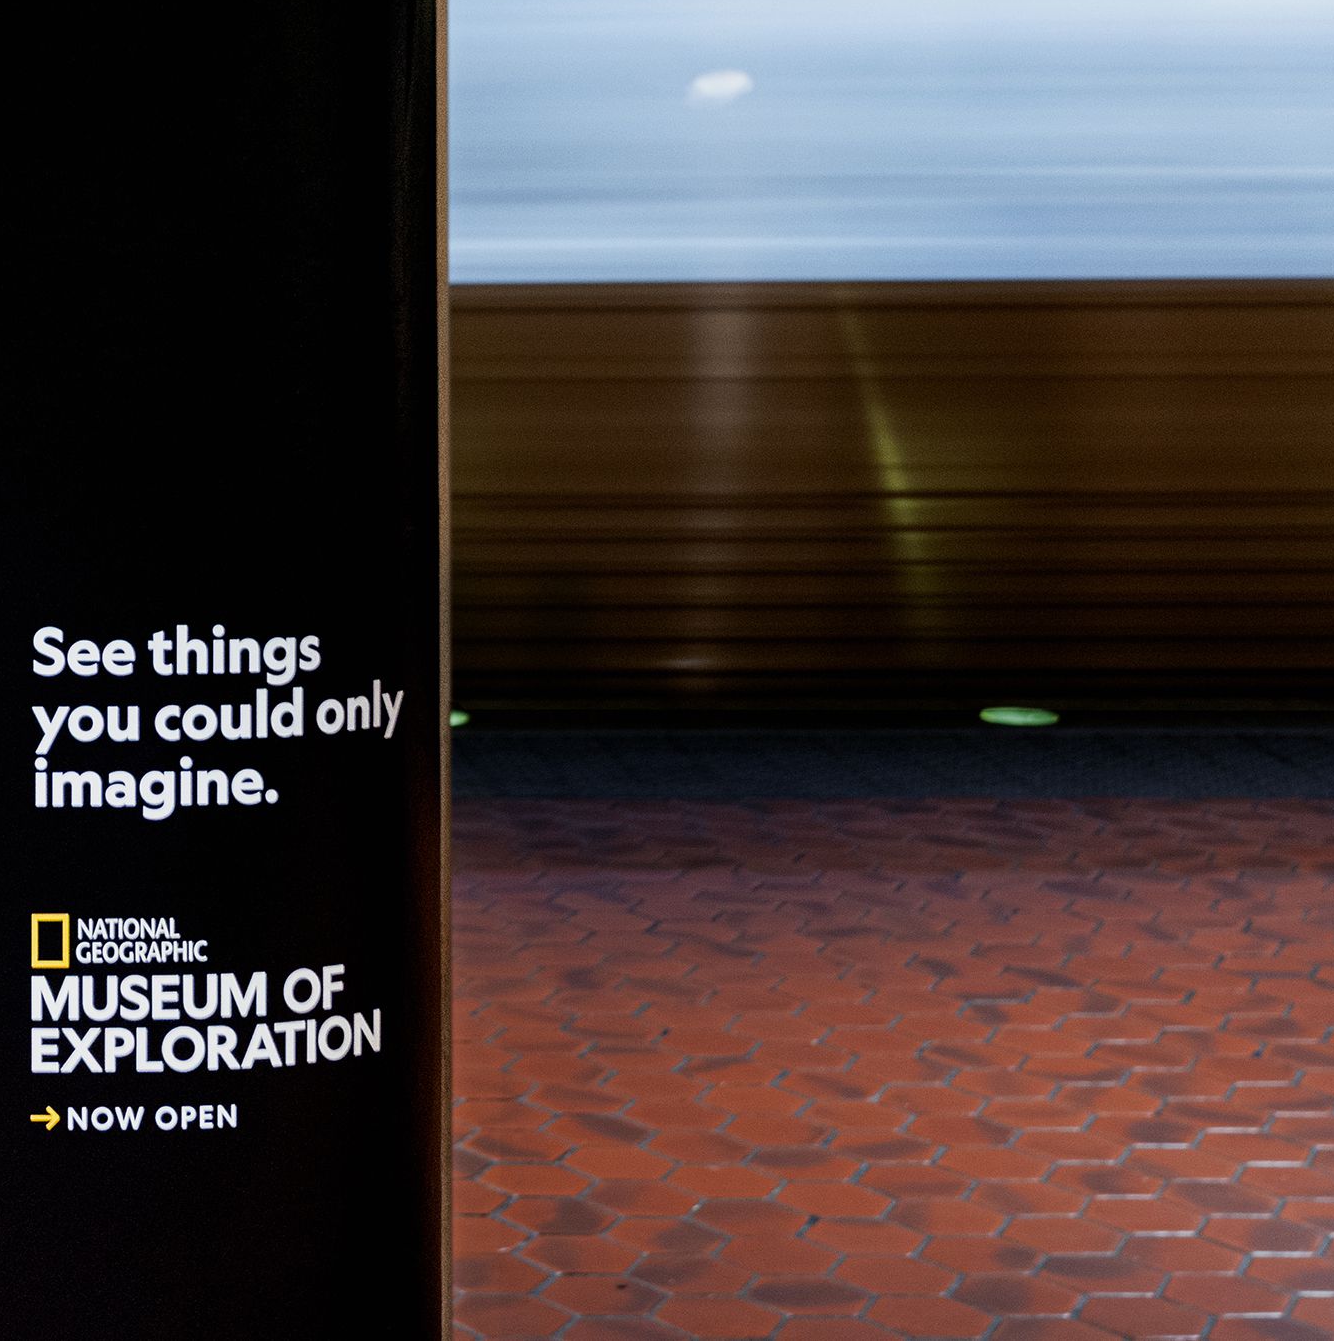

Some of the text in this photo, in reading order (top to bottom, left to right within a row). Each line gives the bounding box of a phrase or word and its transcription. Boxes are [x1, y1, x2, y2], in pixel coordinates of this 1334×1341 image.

[33, 624, 320, 685] See things
[32, 680, 404, 755] you could only
[35, 757, 279, 820] imagine.
[76, 940, 208, 964] GEOGRAPHIC
[78, 917, 180, 939] NATIONAL
[31, 964, 344, 1021] MUSEUM OF
[31, 1007, 381, 1074] EXPLORATION
[68, 1104, 238, 1131] NOW OPEN
